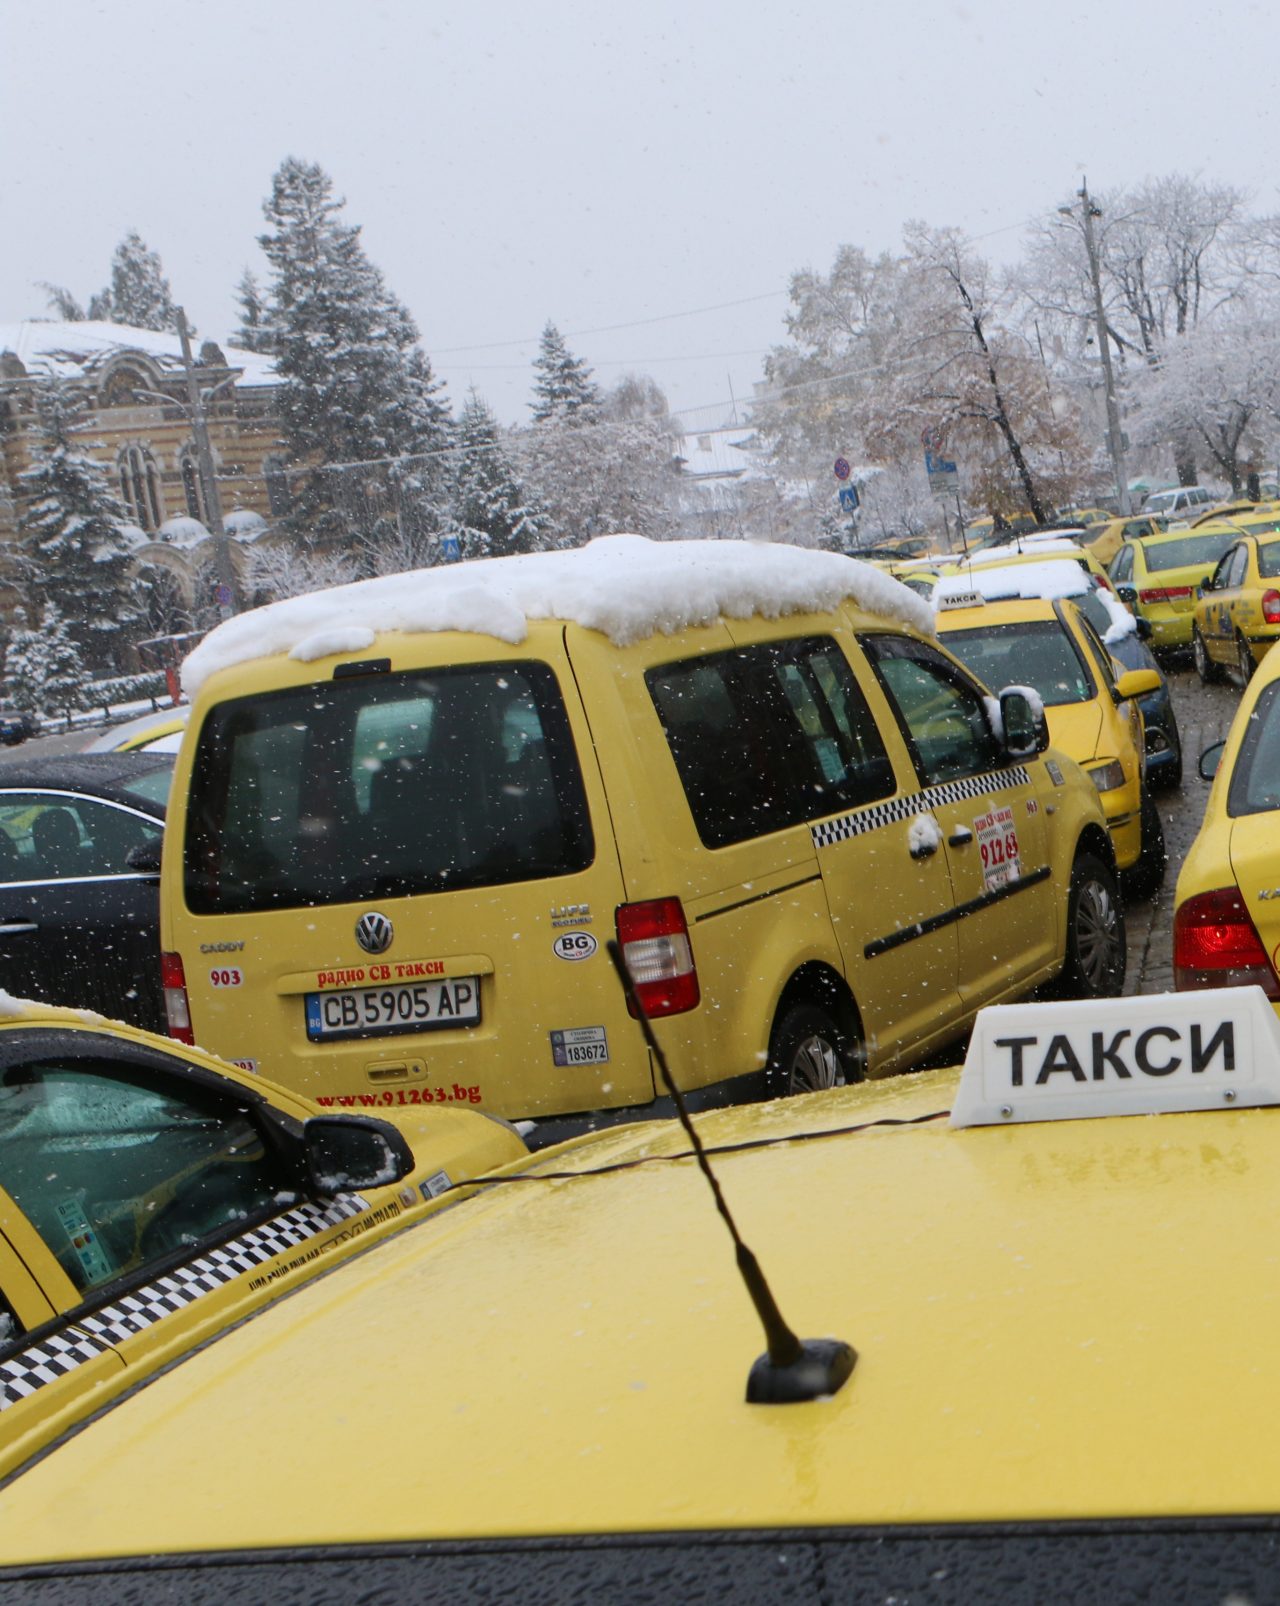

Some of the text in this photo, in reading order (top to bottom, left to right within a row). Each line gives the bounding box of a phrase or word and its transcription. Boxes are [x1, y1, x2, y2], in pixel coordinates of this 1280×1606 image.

[944, 594, 977, 605] ТАКСИ
[562, 936, 589, 951] BG
[210, 969, 242, 986] 903
[363, 986, 431, 1024] 5905
[437, 982, 473, 1017] AP
[309, 1017, 321, 1028] BG
[567, 1043, 607, 1062] 183672
[993, 1020, 1236, 1087] ТАКСИ
[315, 1083, 483, 1107] www.91263.bg
